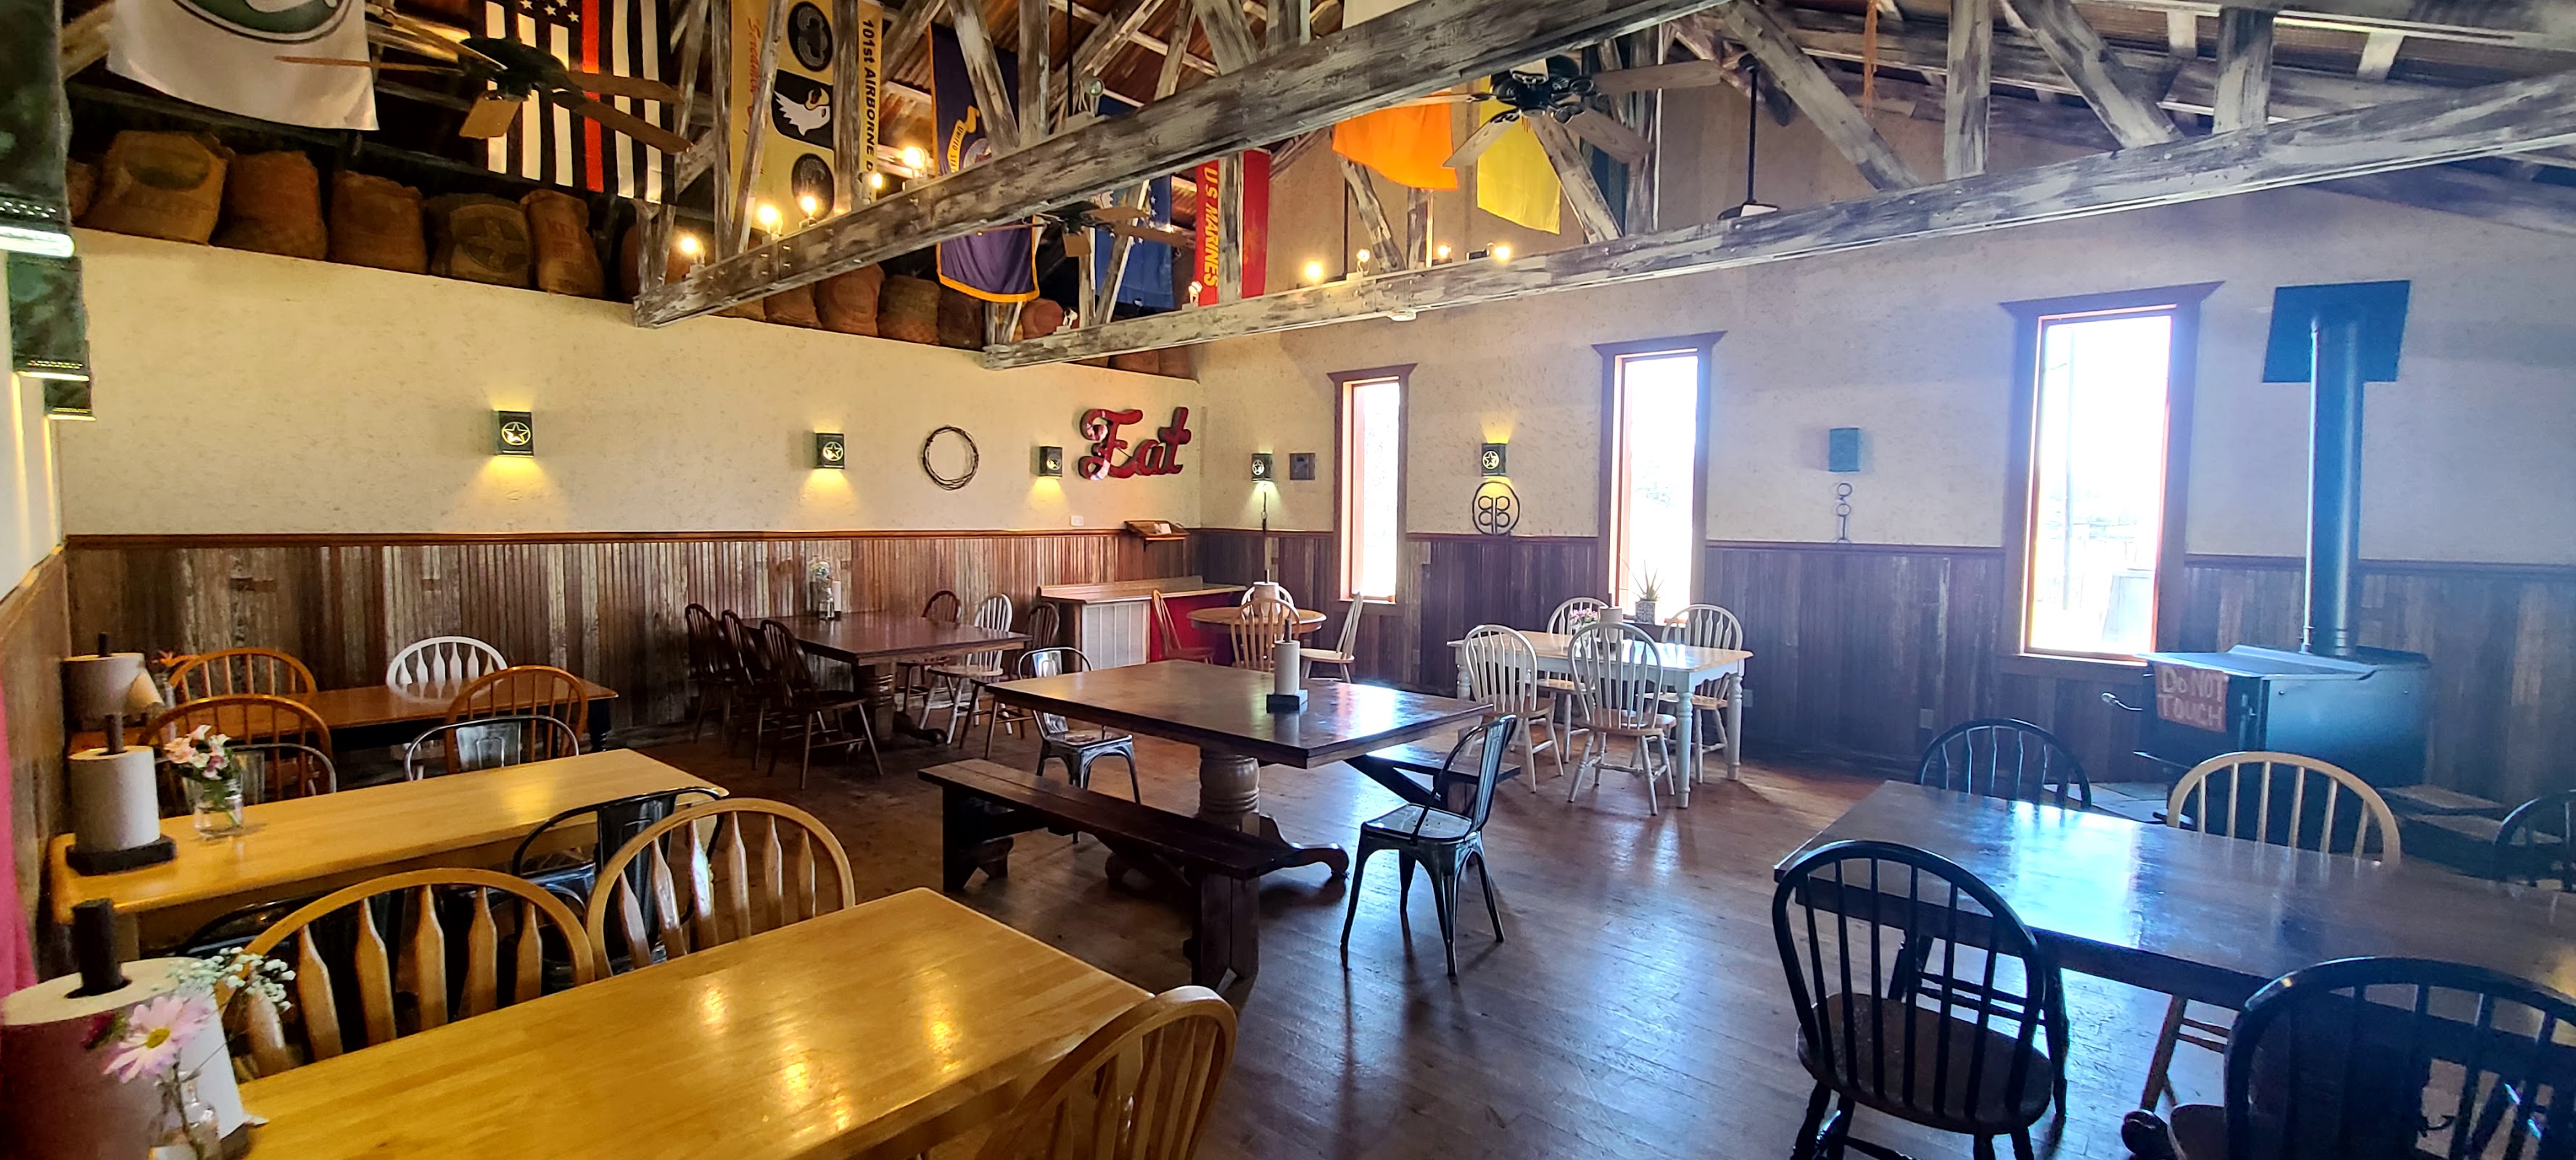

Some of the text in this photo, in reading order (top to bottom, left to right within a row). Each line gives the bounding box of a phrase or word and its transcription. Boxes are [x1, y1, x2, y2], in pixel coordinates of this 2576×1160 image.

[862, 20, 875, 64] 101st
[864, 66, 876, 156] AIRBORNE
[1204, 202, 1219, 287] MARINES
[1078, 407, 1192, 481] Eat
[2158, 692, 2224, 728] TOUCH
[2190, 669, 2229, 703] NOT
